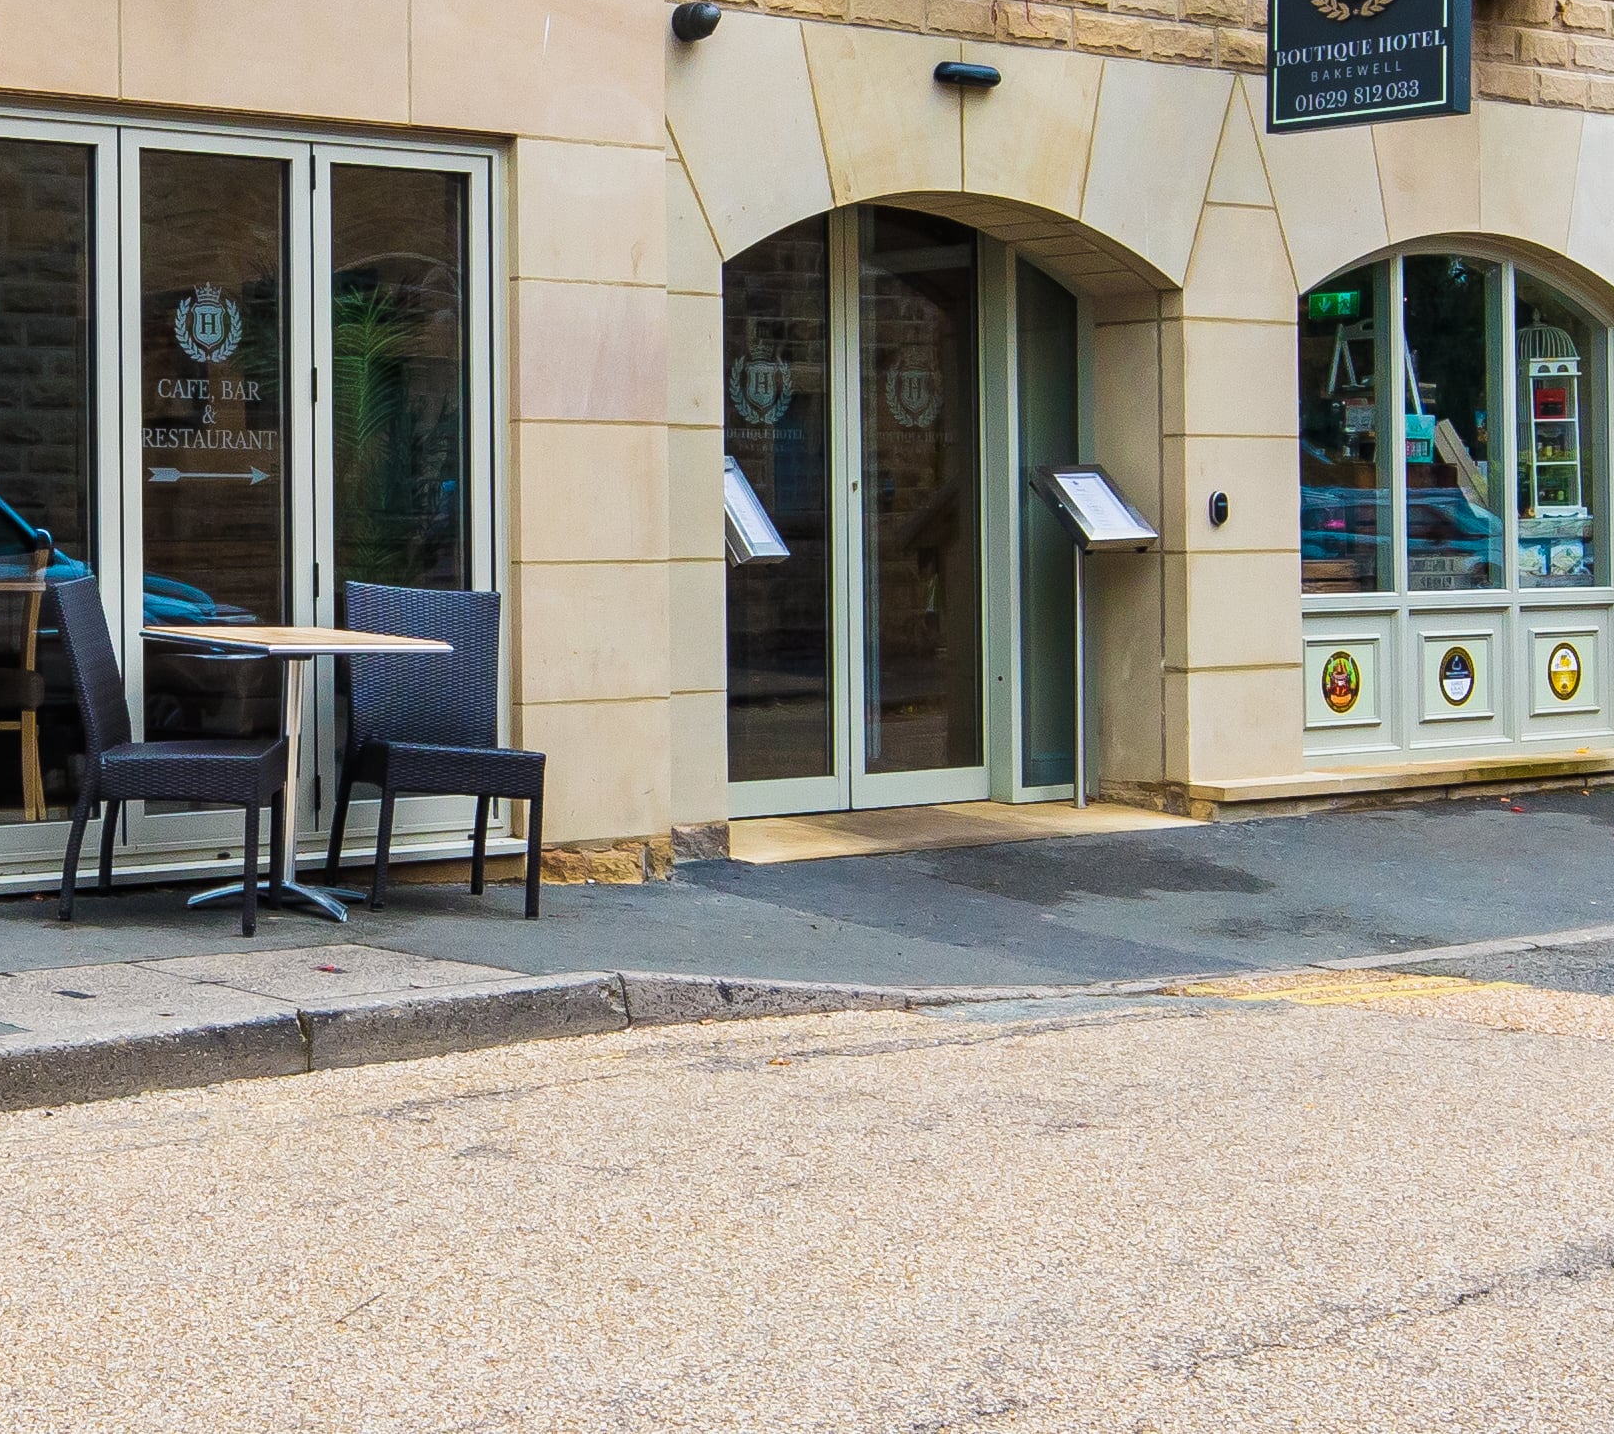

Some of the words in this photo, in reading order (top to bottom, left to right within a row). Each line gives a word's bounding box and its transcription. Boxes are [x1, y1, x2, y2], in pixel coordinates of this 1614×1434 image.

[1276, 38, 1372, 67] BOUTIQUE
[1378, 29, 1445, 54] HOTEL
[1311, 60, 1402, 82] BAKEWELL
[1295, 90, 1348, 112] 01629
[1353, 85, 1382, 105] 812
[1386, 80, 1419, 100] 033
[200, 312, 217, 334] H
[157, 378, 214, 403] CAFE,
[222, 380, 262, 401] BAR
[202, 404, 217, 424] &
[142, 428, 277, 451] RESTAURANT
[727, 428, 772, 441] OUTIQUE
